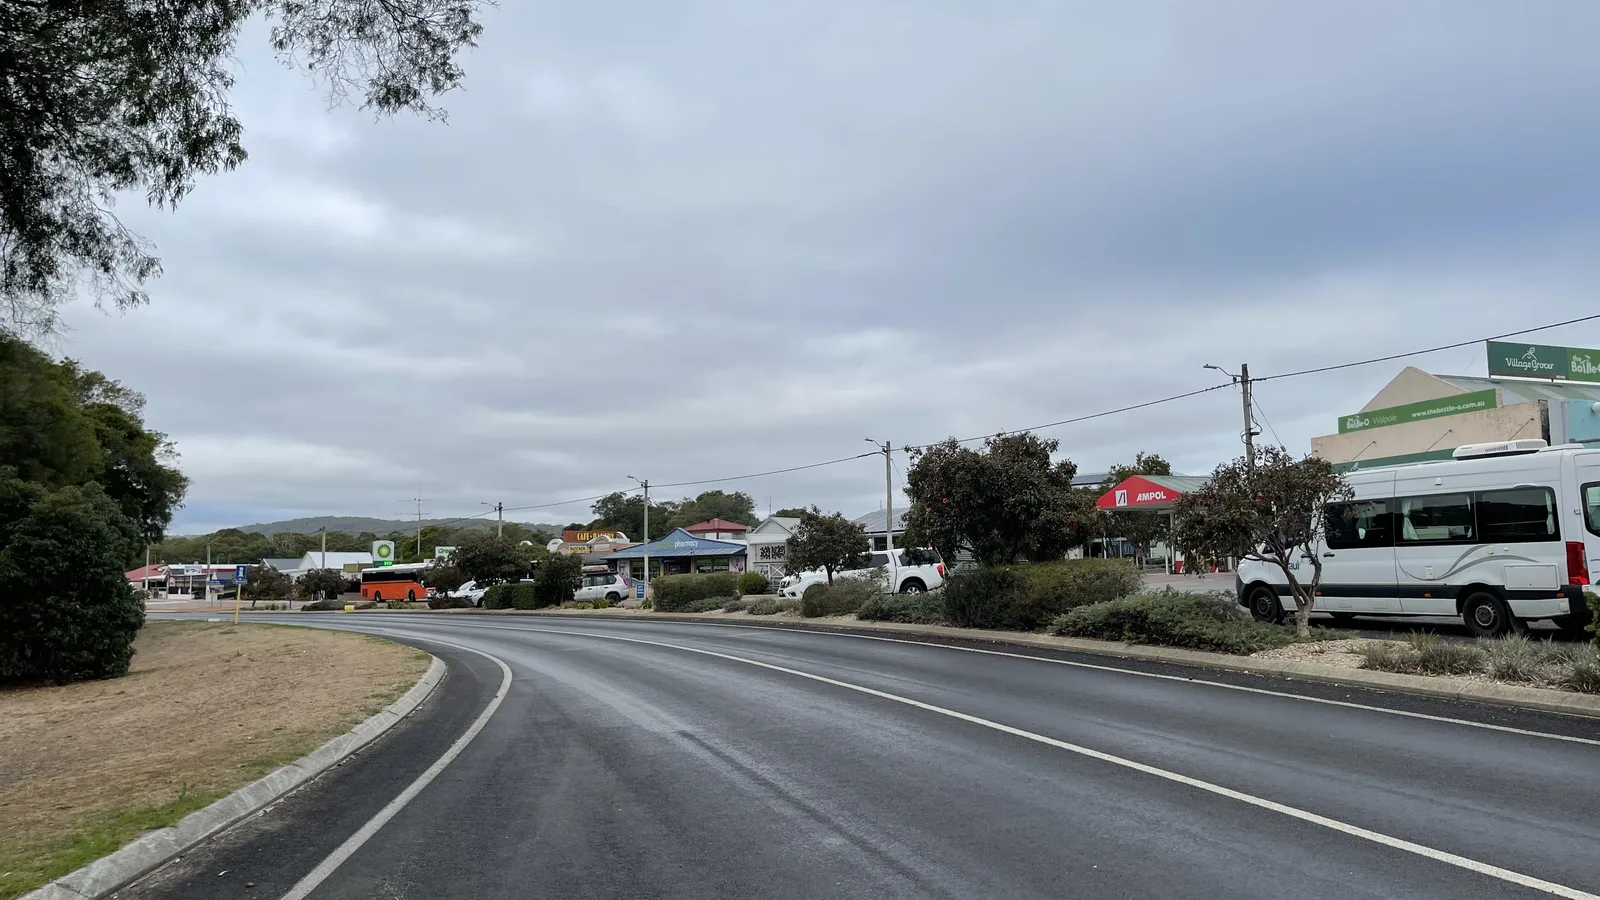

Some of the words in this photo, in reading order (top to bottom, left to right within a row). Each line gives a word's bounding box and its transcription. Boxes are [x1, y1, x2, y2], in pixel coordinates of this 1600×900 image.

[1411, 400, 1486, 418] www.thebottle-o.com.au
[1372, 414, 1398, 425] Walpole
[1136, 491, 1166, 502] AMPOL
[576, 532, 590, 541] CAFE
[674, 540, 699, 549] pharmacy
